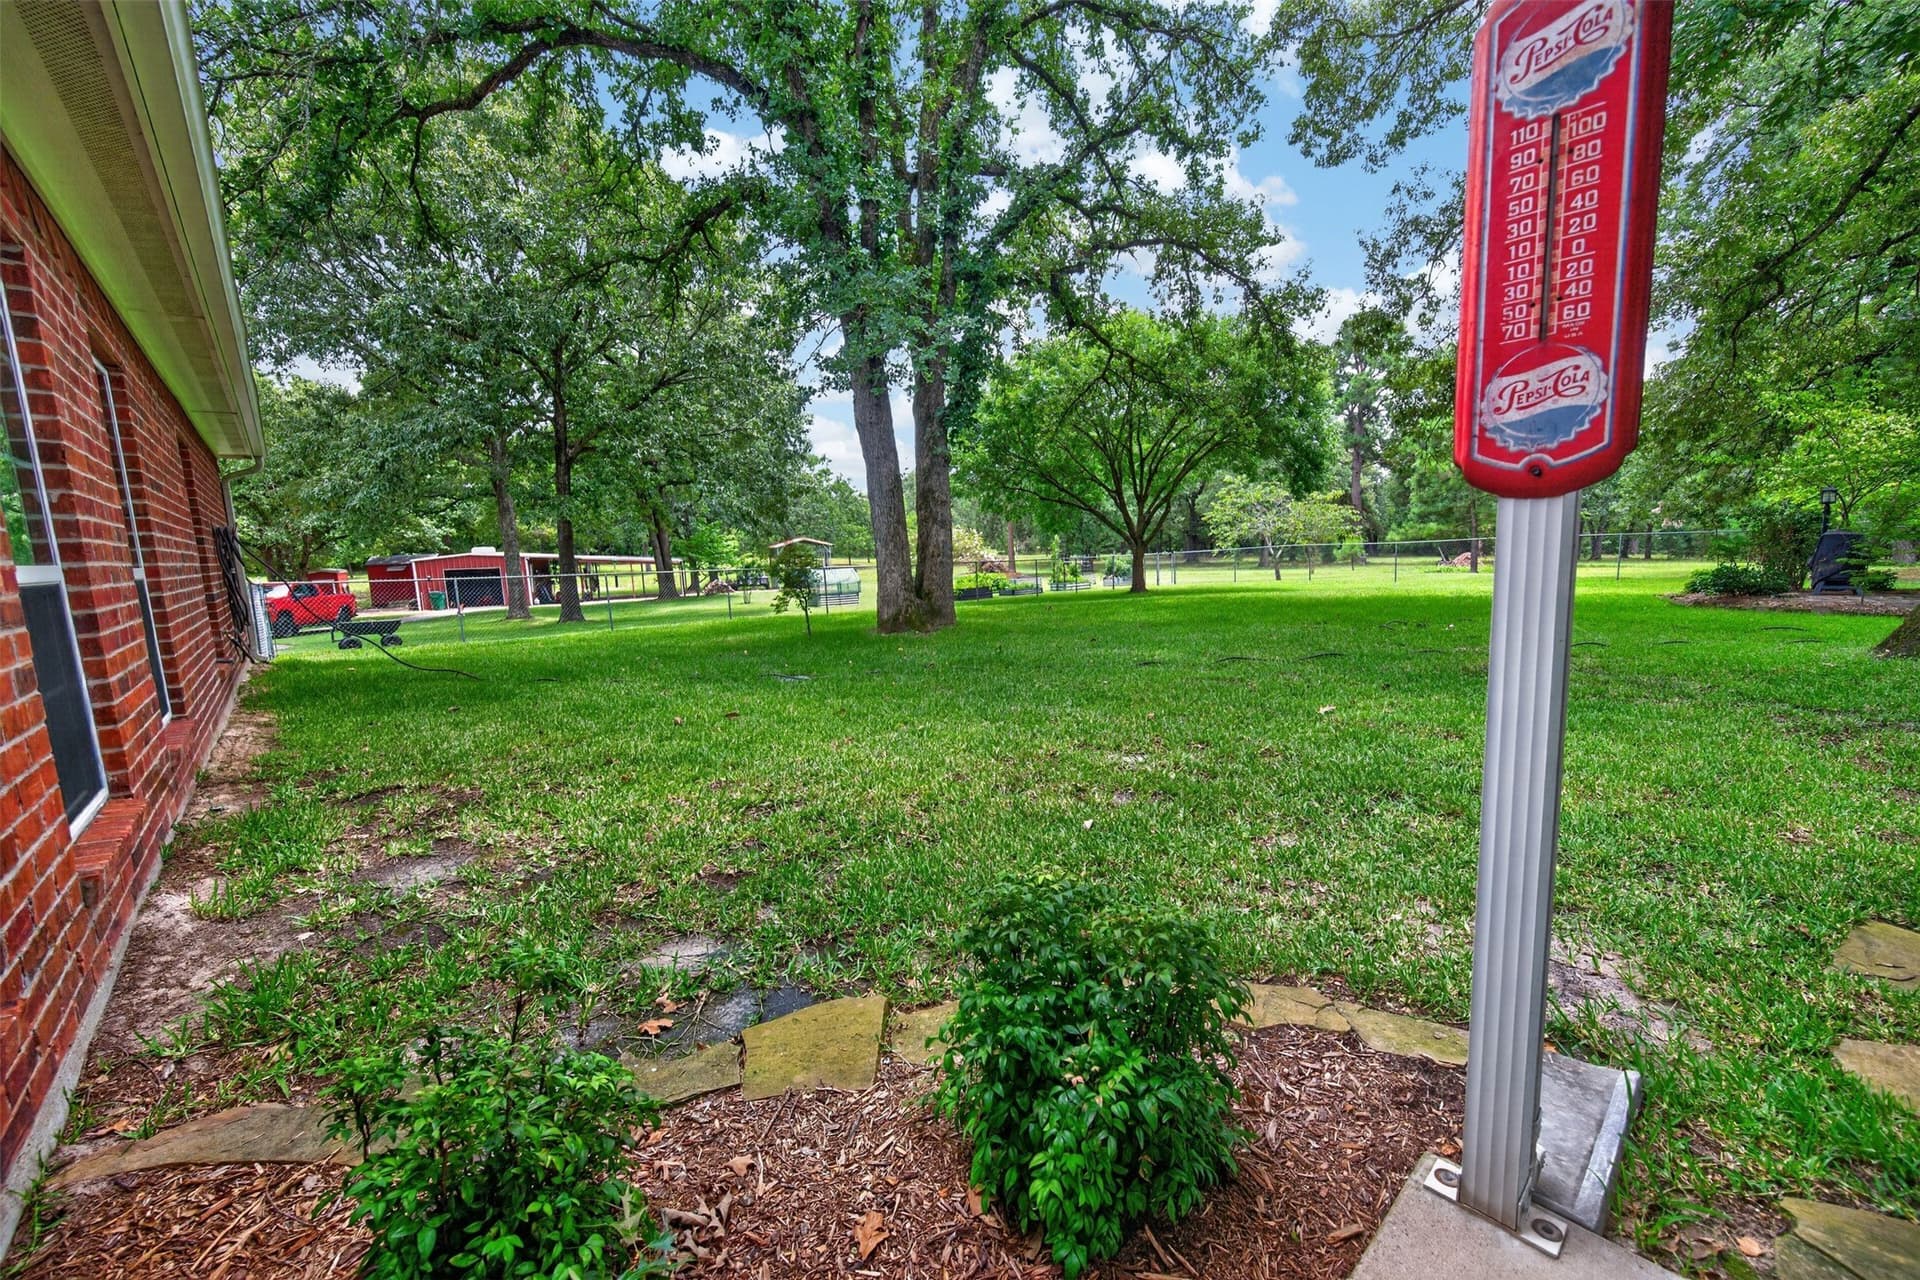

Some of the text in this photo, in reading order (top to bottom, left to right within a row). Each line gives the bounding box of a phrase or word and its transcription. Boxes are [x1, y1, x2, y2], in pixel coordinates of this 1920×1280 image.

[1570, 111, 1606, 136] 100
[1511, 123, 1538, 145] 110
[1510, 148, 1536, 169] 90
[1573, 139, 1601, 161] 80
[1510, 173, 1534, 193] 70
[1571, 165, 1599, 187] 60
[1508, 197, 1533, 217] 50
[1570, 189, 1598, 209] 40
[1507, 219, 1532, 240] 30
[1568, 213, 1596, 234] 20
[1509, 242, 1530, 259] 10
[1572, 238, 1585, 254] 0
[1508, 263, 1529, 281] 10
[1566, 259, 1593, 278] 20
[1504, 284, 1528, 300] 30
[1565, 280, 1592, 296] 40
[1502, 304, 1527, 320] 50
[1563, 302, 1590, 320] 60
[1502, 323, 1525, 340] 70
